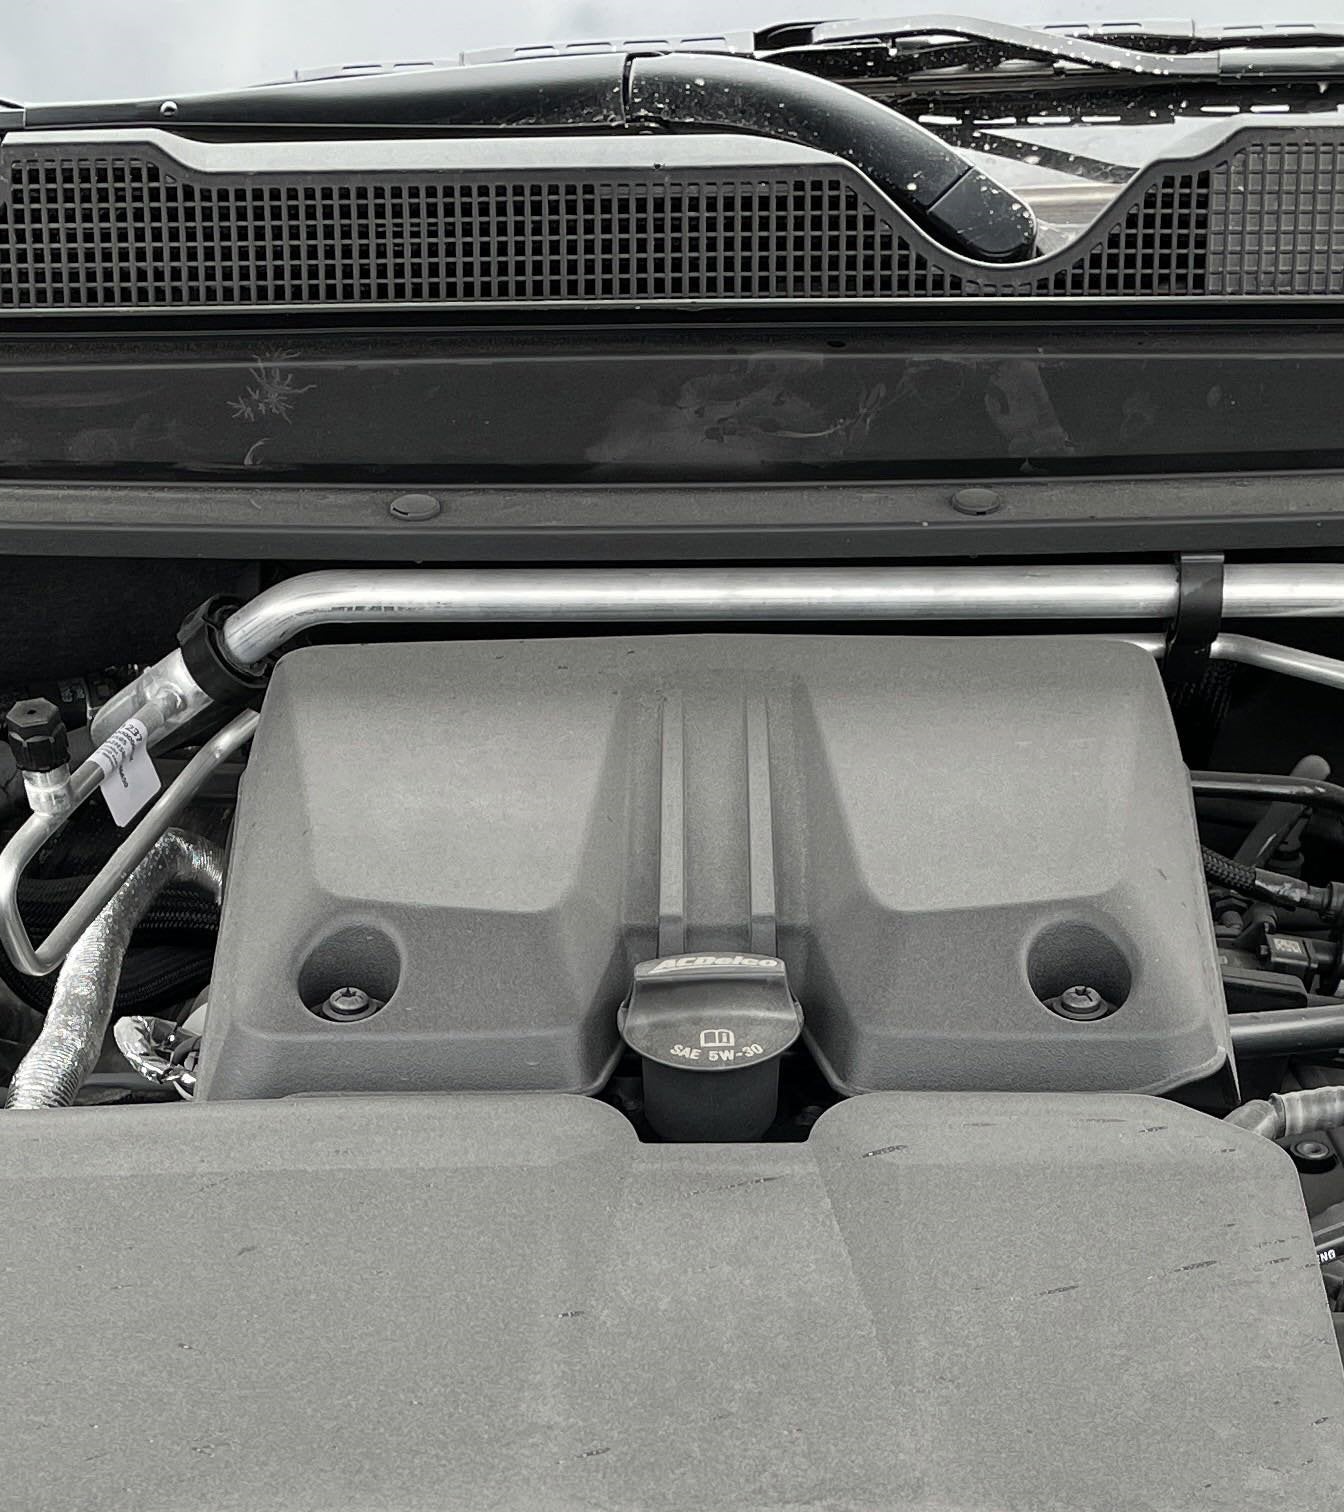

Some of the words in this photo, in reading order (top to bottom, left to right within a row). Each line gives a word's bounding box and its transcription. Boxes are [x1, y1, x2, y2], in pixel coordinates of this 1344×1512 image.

[649, 956, 777, 974] ACDelco
[670, 1044, 702, 1060] SAE
[708, 1043, 764, 1061] 5W-30
